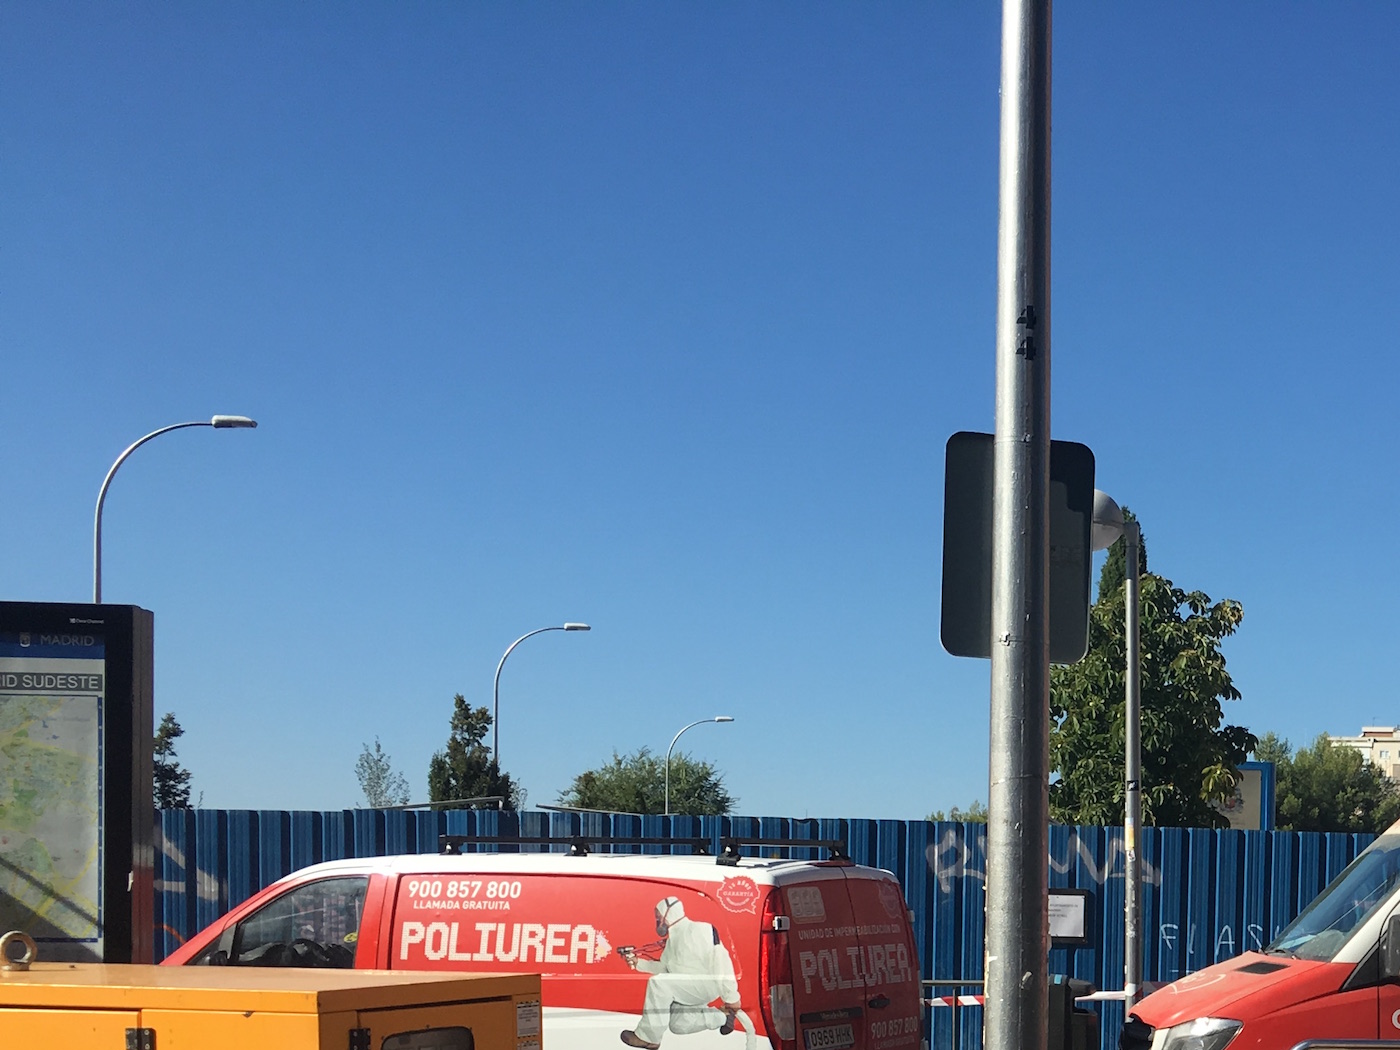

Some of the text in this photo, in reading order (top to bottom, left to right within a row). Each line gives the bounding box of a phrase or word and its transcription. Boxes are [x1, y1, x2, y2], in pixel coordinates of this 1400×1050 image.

[40, 634, 94, 646] MADRID
[0, 675, 99, 689] ID SUDESTE
[408, 880, 522, 899] 900 857 800
[413, 899, 510, 910] LLAMADA GRATUITA
[400, 921, 596, 964] POLIUREA
[798, 927, 824, 940] UNIDAD
[825, 927, 834, 938] DE
[799, 943, 912, 994] POLIUREA
[871, 1016, 918, 1039] 900 857 800
[811, 1029, 834, 1047] 0969
